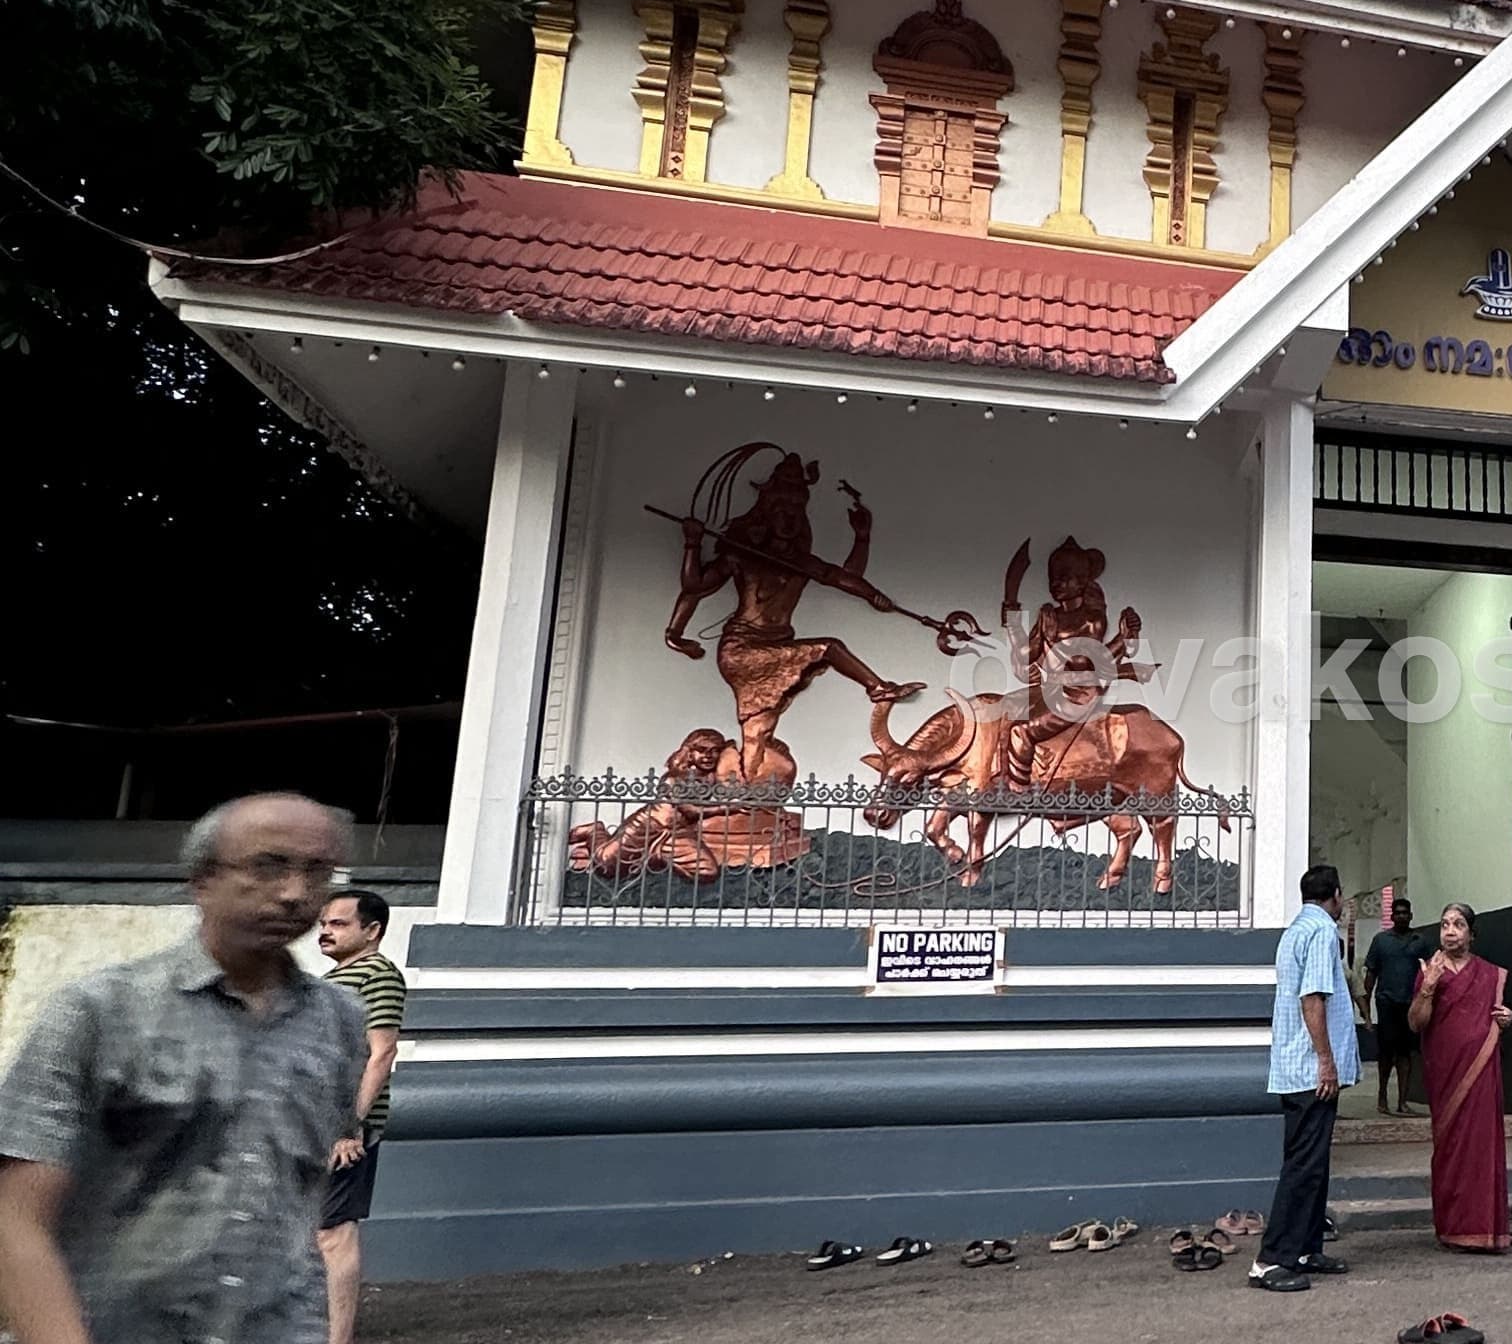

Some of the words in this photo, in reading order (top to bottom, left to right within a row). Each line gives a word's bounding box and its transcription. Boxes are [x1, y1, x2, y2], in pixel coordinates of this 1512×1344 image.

[1337, 327, 1416, 370] ഓം
[882, 932, 909, 953] NO
[913, 932, 993, 953] PARKING
